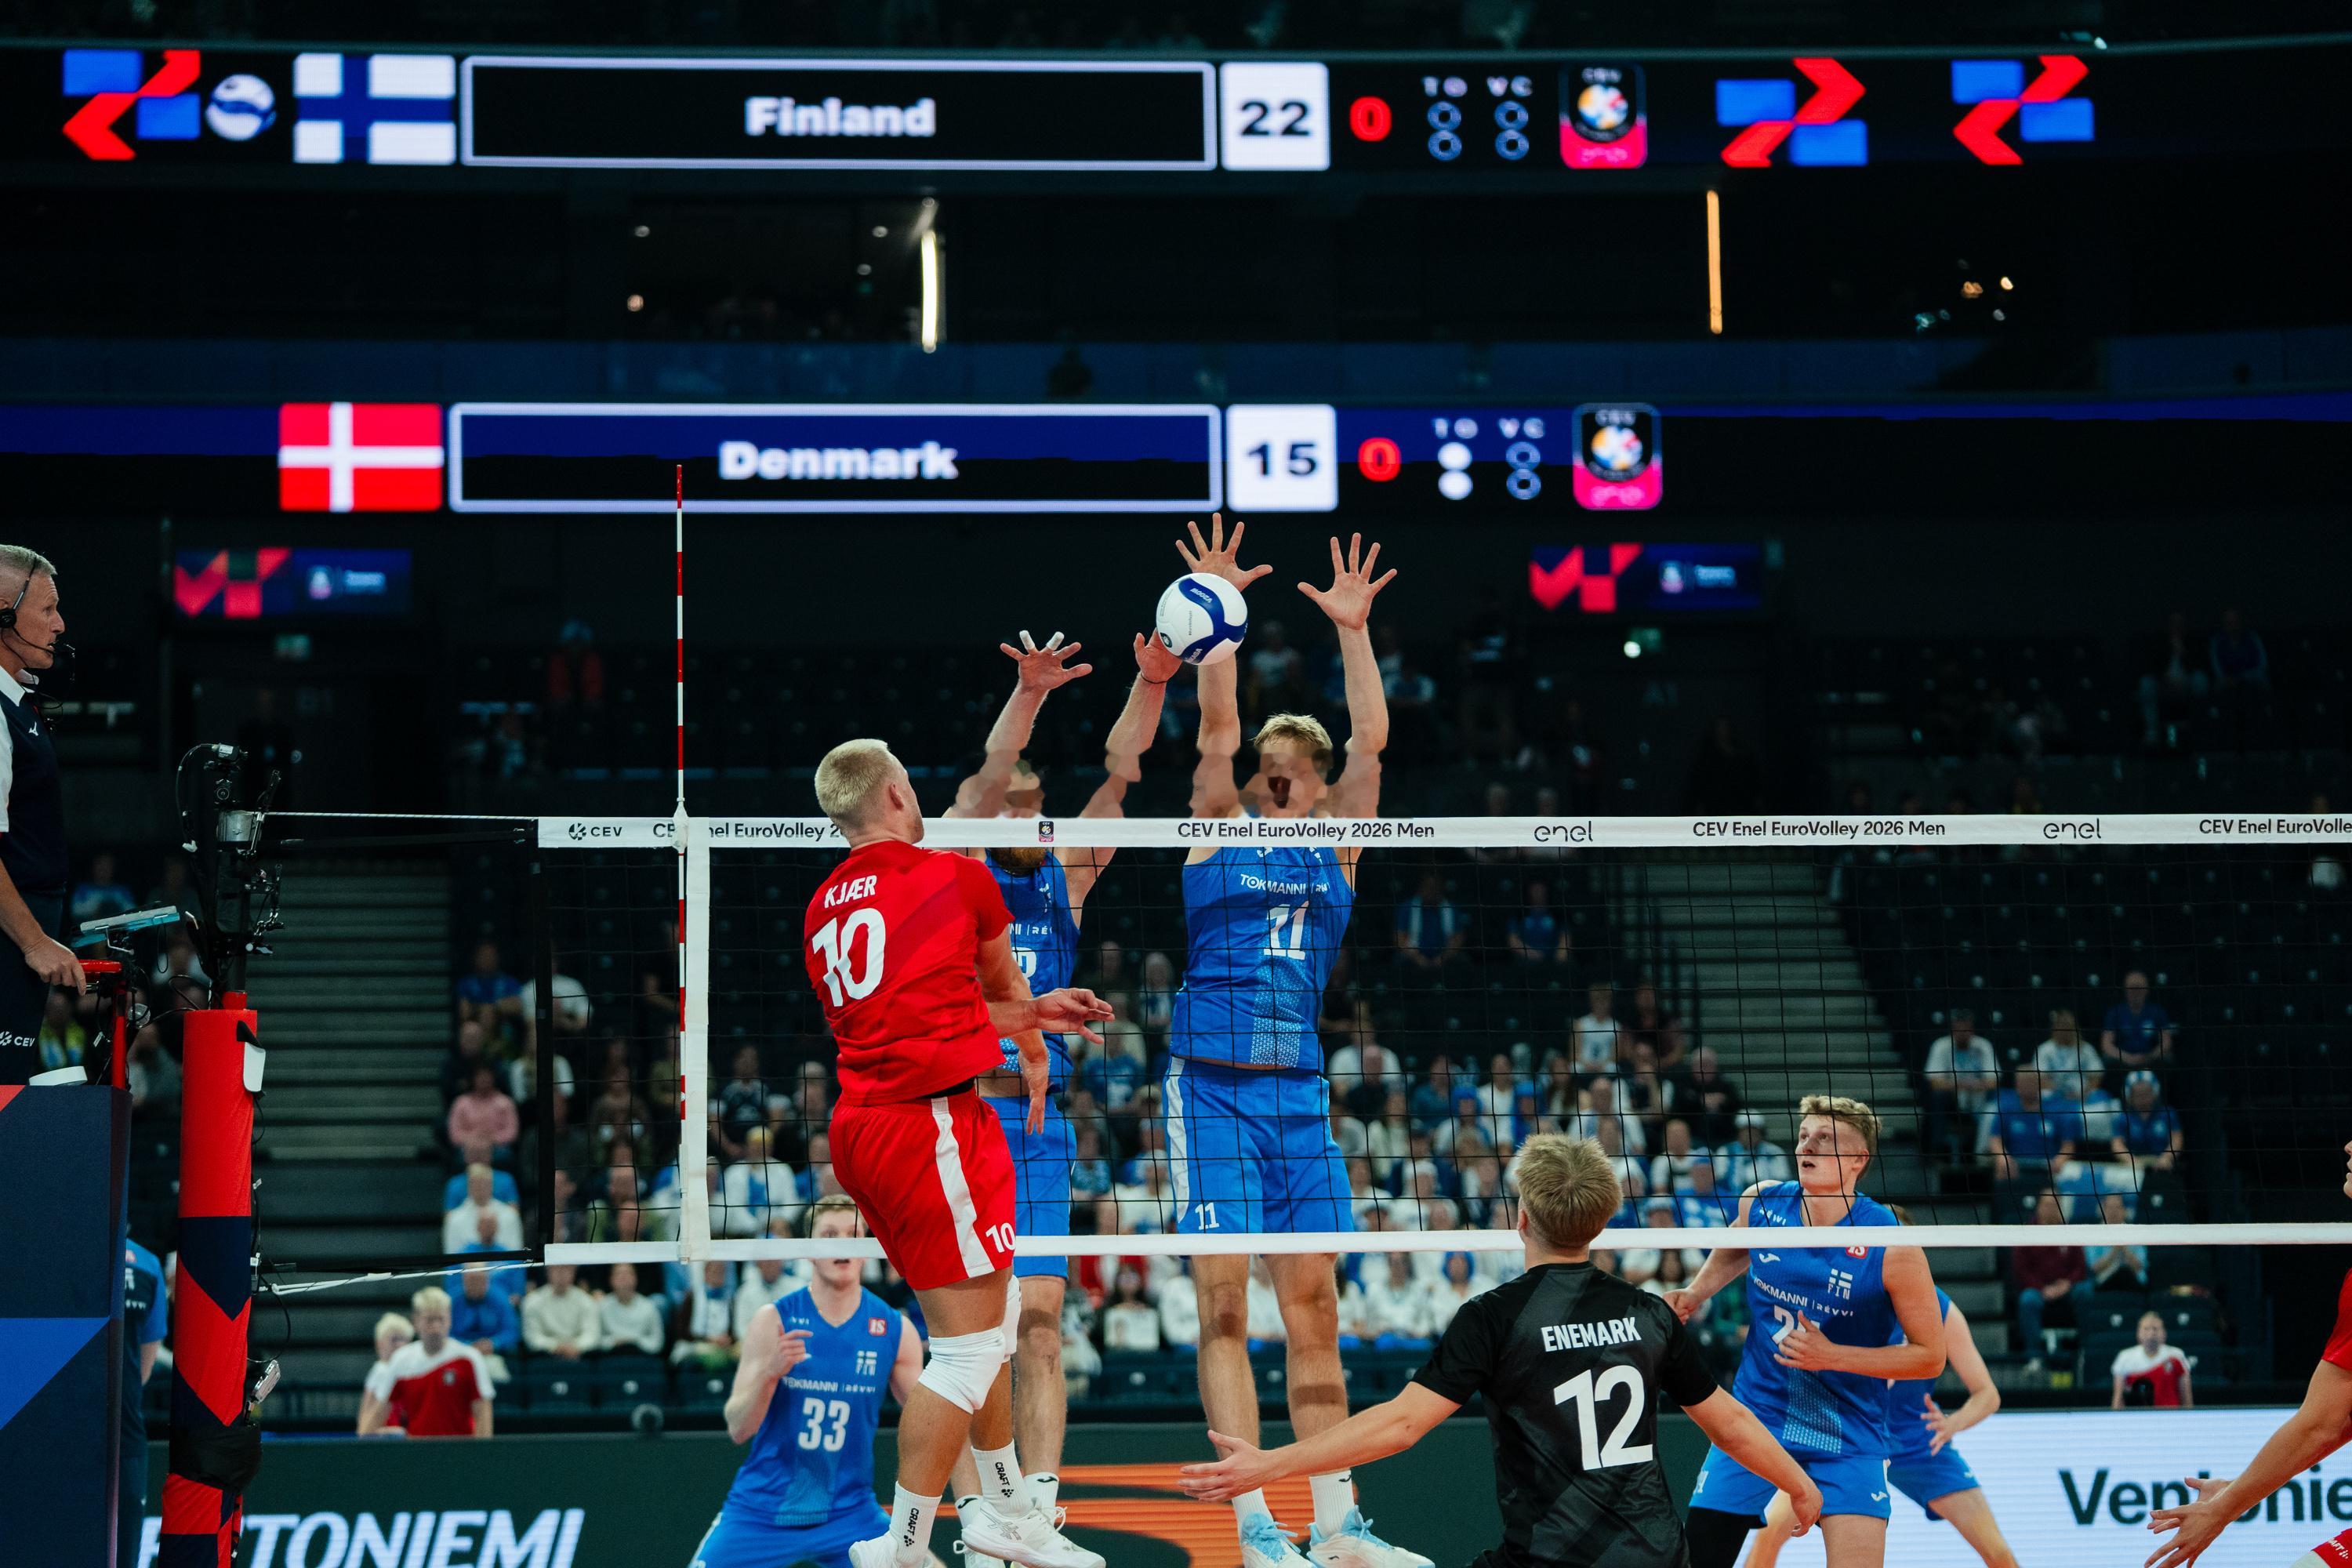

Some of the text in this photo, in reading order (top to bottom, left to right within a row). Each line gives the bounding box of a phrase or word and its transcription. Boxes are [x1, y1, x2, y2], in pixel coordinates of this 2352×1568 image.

[746, 96, 935, 136] Finland
[1241, 100, 1311, 136] 22
[1349, 96, 1392, 141] 0
[719, 441, 958, 480] Denmark
[1248, 442, 1317, 477] 15
[1358, 437, 1401, 481] 0
[590, 826, 622, 837] CEV
[652, 822, 676, 838] CE
[735, 822, 826, 842] EuroVolley
[1178, 822, 1435, 842] CEV Enel EuroVolley 2026 Men
[1534, 820, 1594, 843] enel
[1693, 820, 1945, 839] CEV Enel EuroVolley 2026 Men
[2042, 818, 2102, 840] enel
[2198, 818, 2234, 834] CEV
[2238, 818, 2272, 834] Enel
[824, 875, 877, 909] KJÆR
[1240, 873, 1307, 895] TOKMANNI
[811, 907, 886, 1007] 10
[14, 1036, 35, 1047] CEV
[1195, 1202, 1220, 1230] 11
[985, 1222, 1016, 1253] 10
[1828, 1283, 1850, 1301] FIN
[1541, 1317, 1642, 1352] ENEMARK
[798, 1397, 851, 1452] 33
[1553, 1364, 1653, 1471] 12
[995, 1461, 1010, 1486] CRAFT
[907, 1507, 920, 1536] CRAFT
